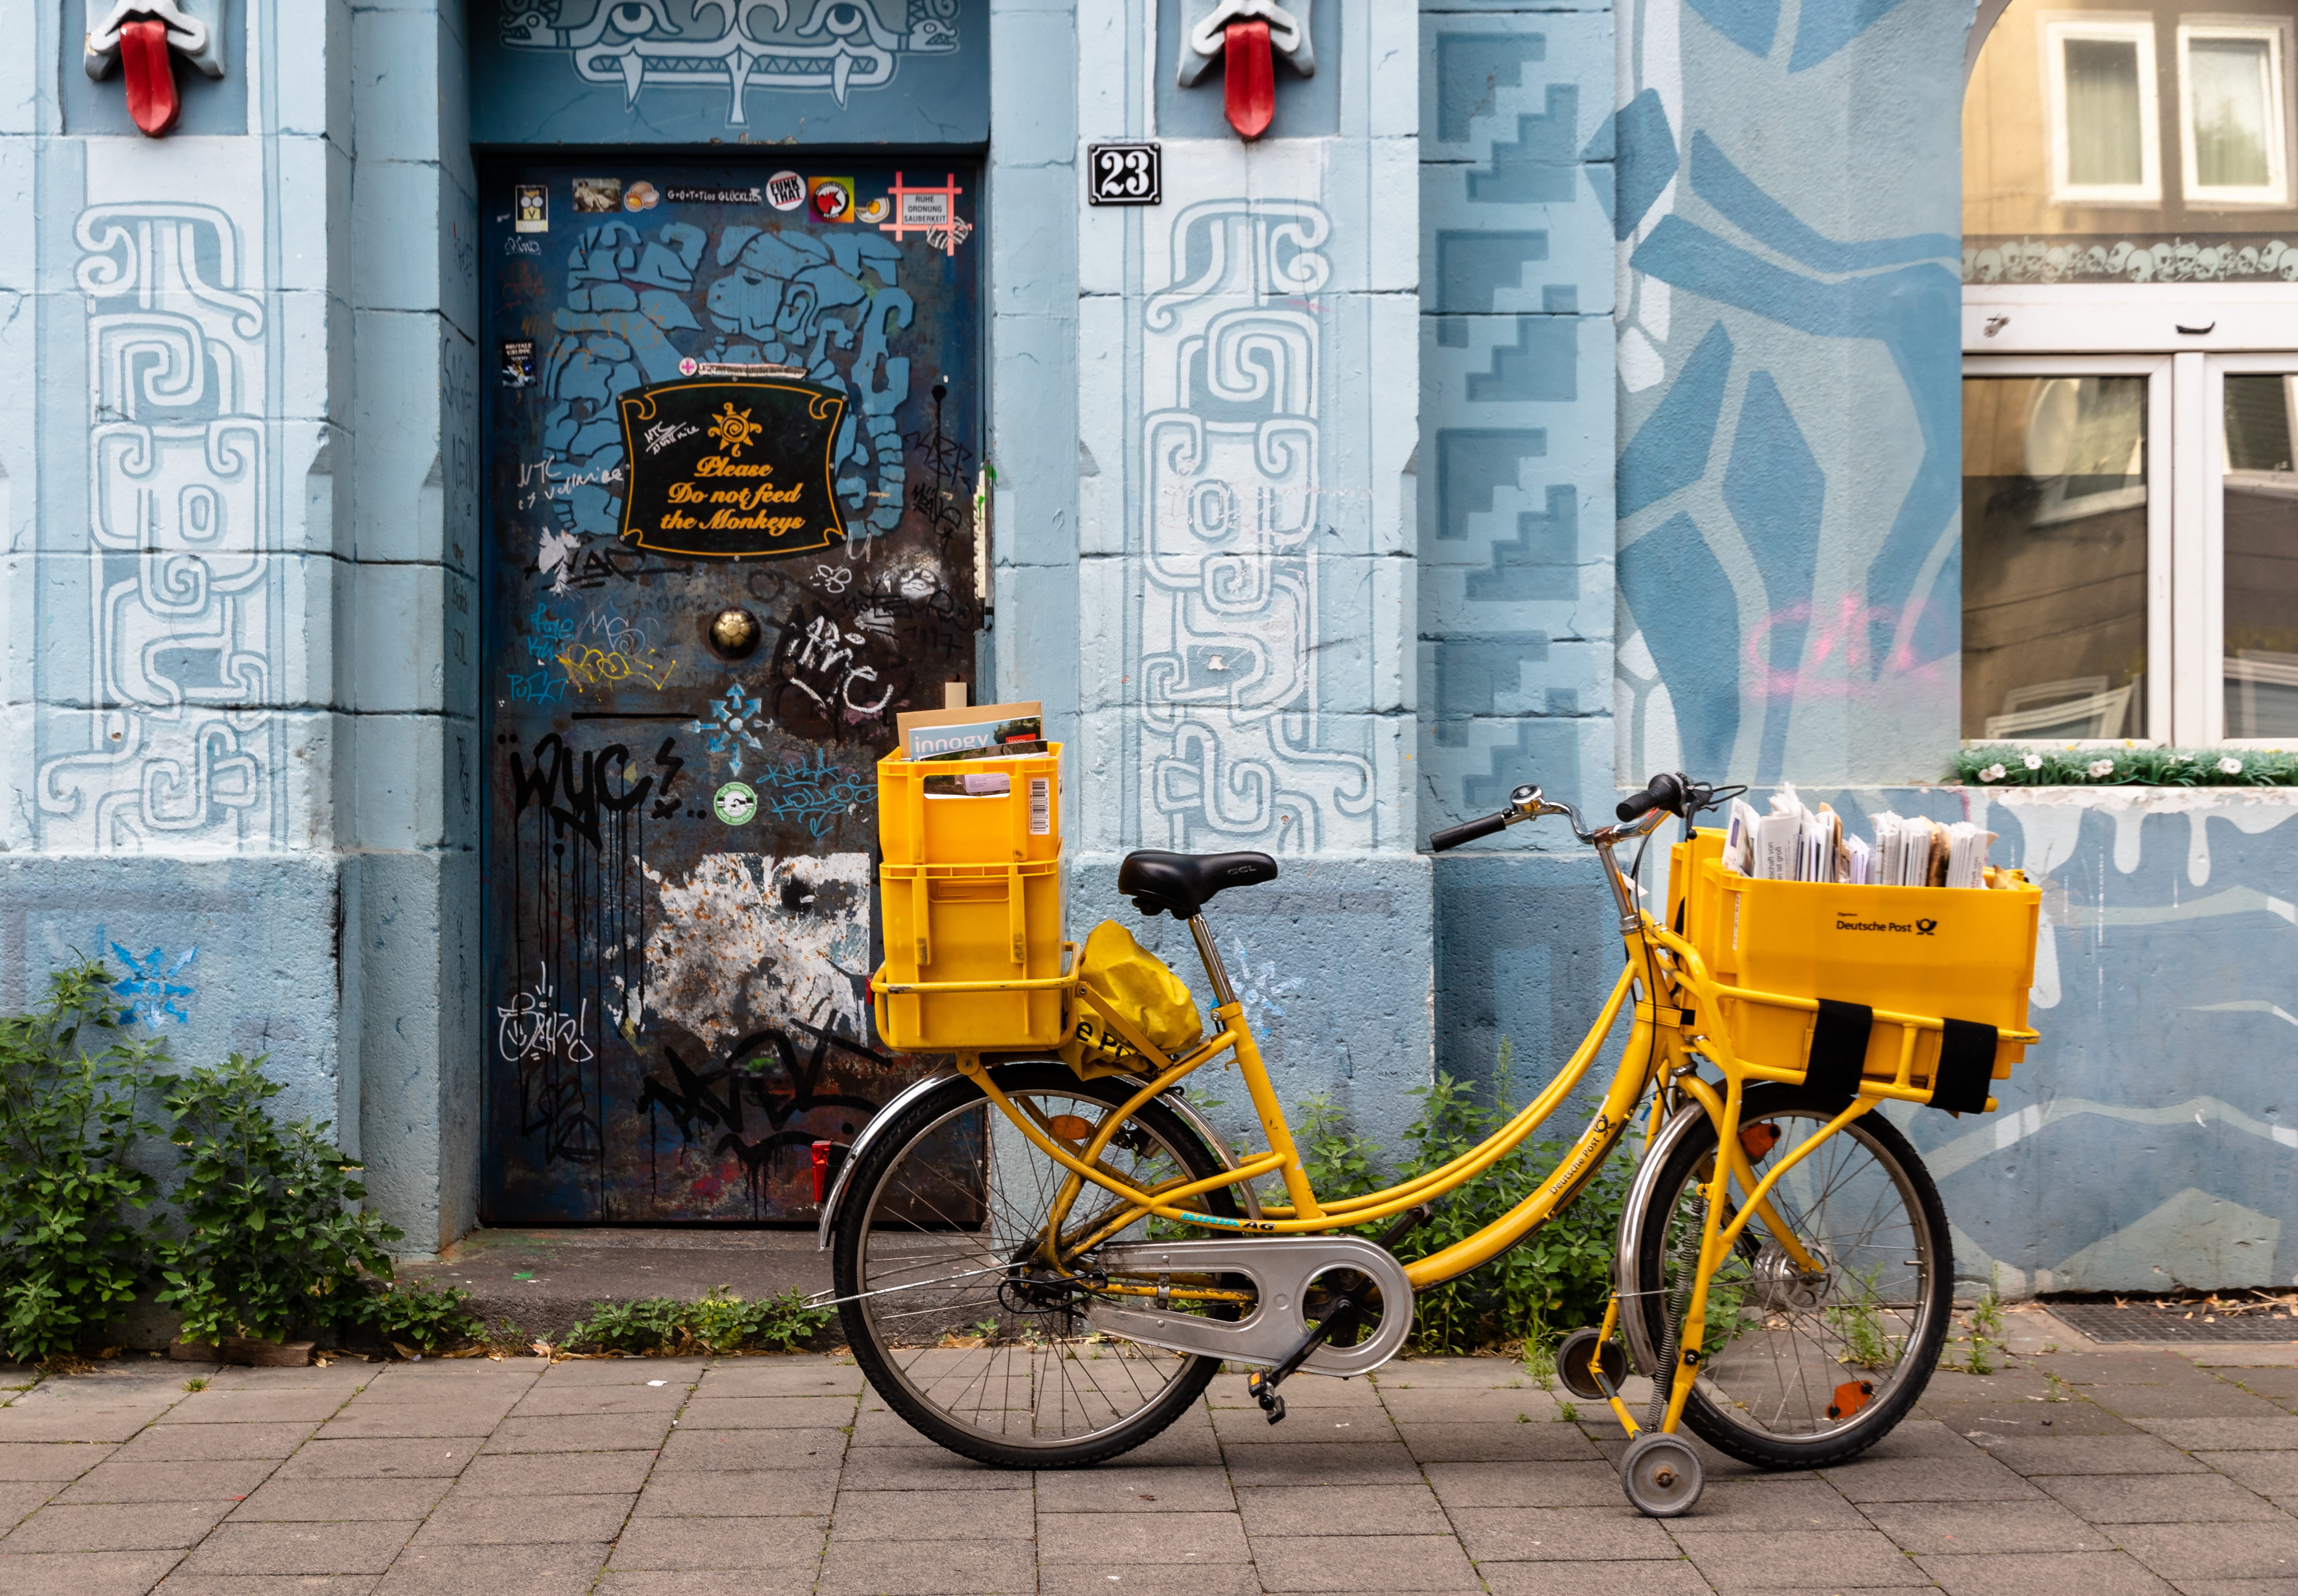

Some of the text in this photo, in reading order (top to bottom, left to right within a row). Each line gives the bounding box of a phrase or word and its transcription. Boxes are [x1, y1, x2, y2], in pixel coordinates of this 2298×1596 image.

[1101, 151, 1149, 196] 23
[770, 178, 800, 196] FUNK
[774, 187, 801, 204] THAT
[908, 205, 942, 213] ORDNUNG
[518, 454, 561, 488] NTC
[694, 456, 773, 477] Please
[667, 482, 803, 510] Do not feed
[660, 509, 806, 537] the Monkeys
[719, 784, 752, 797] LIVE TOGETHER
[731, 808, 753, 823] TOGETHER
[1775, 847, 1783, 862] groß
[1836, 920, 1912, 933] Deutsche Post
[1549, 1137, 1600, 1195] Deutsche Post
[1180, 1212, 1276, 1231] BIRIA AG
